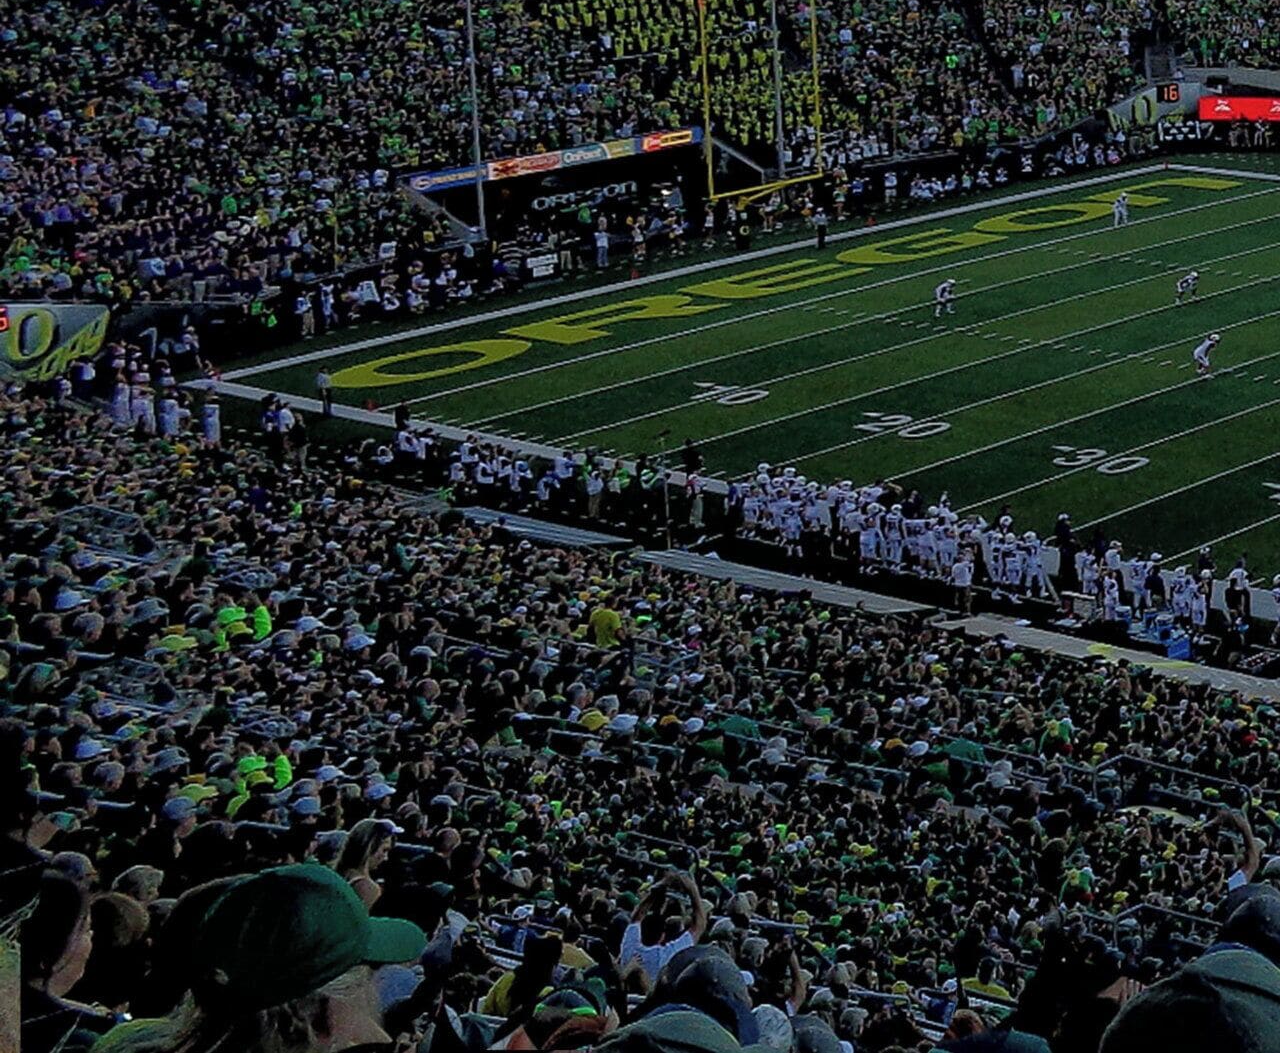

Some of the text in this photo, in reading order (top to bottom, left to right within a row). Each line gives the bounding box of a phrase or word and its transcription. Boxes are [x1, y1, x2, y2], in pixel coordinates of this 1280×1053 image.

[1163, 84, 1178, 101] 16
[330, 176, 1244, 388] OREGON
[853, 414, 951, 439] 20
[1052, 448, 1150, 475] 30
